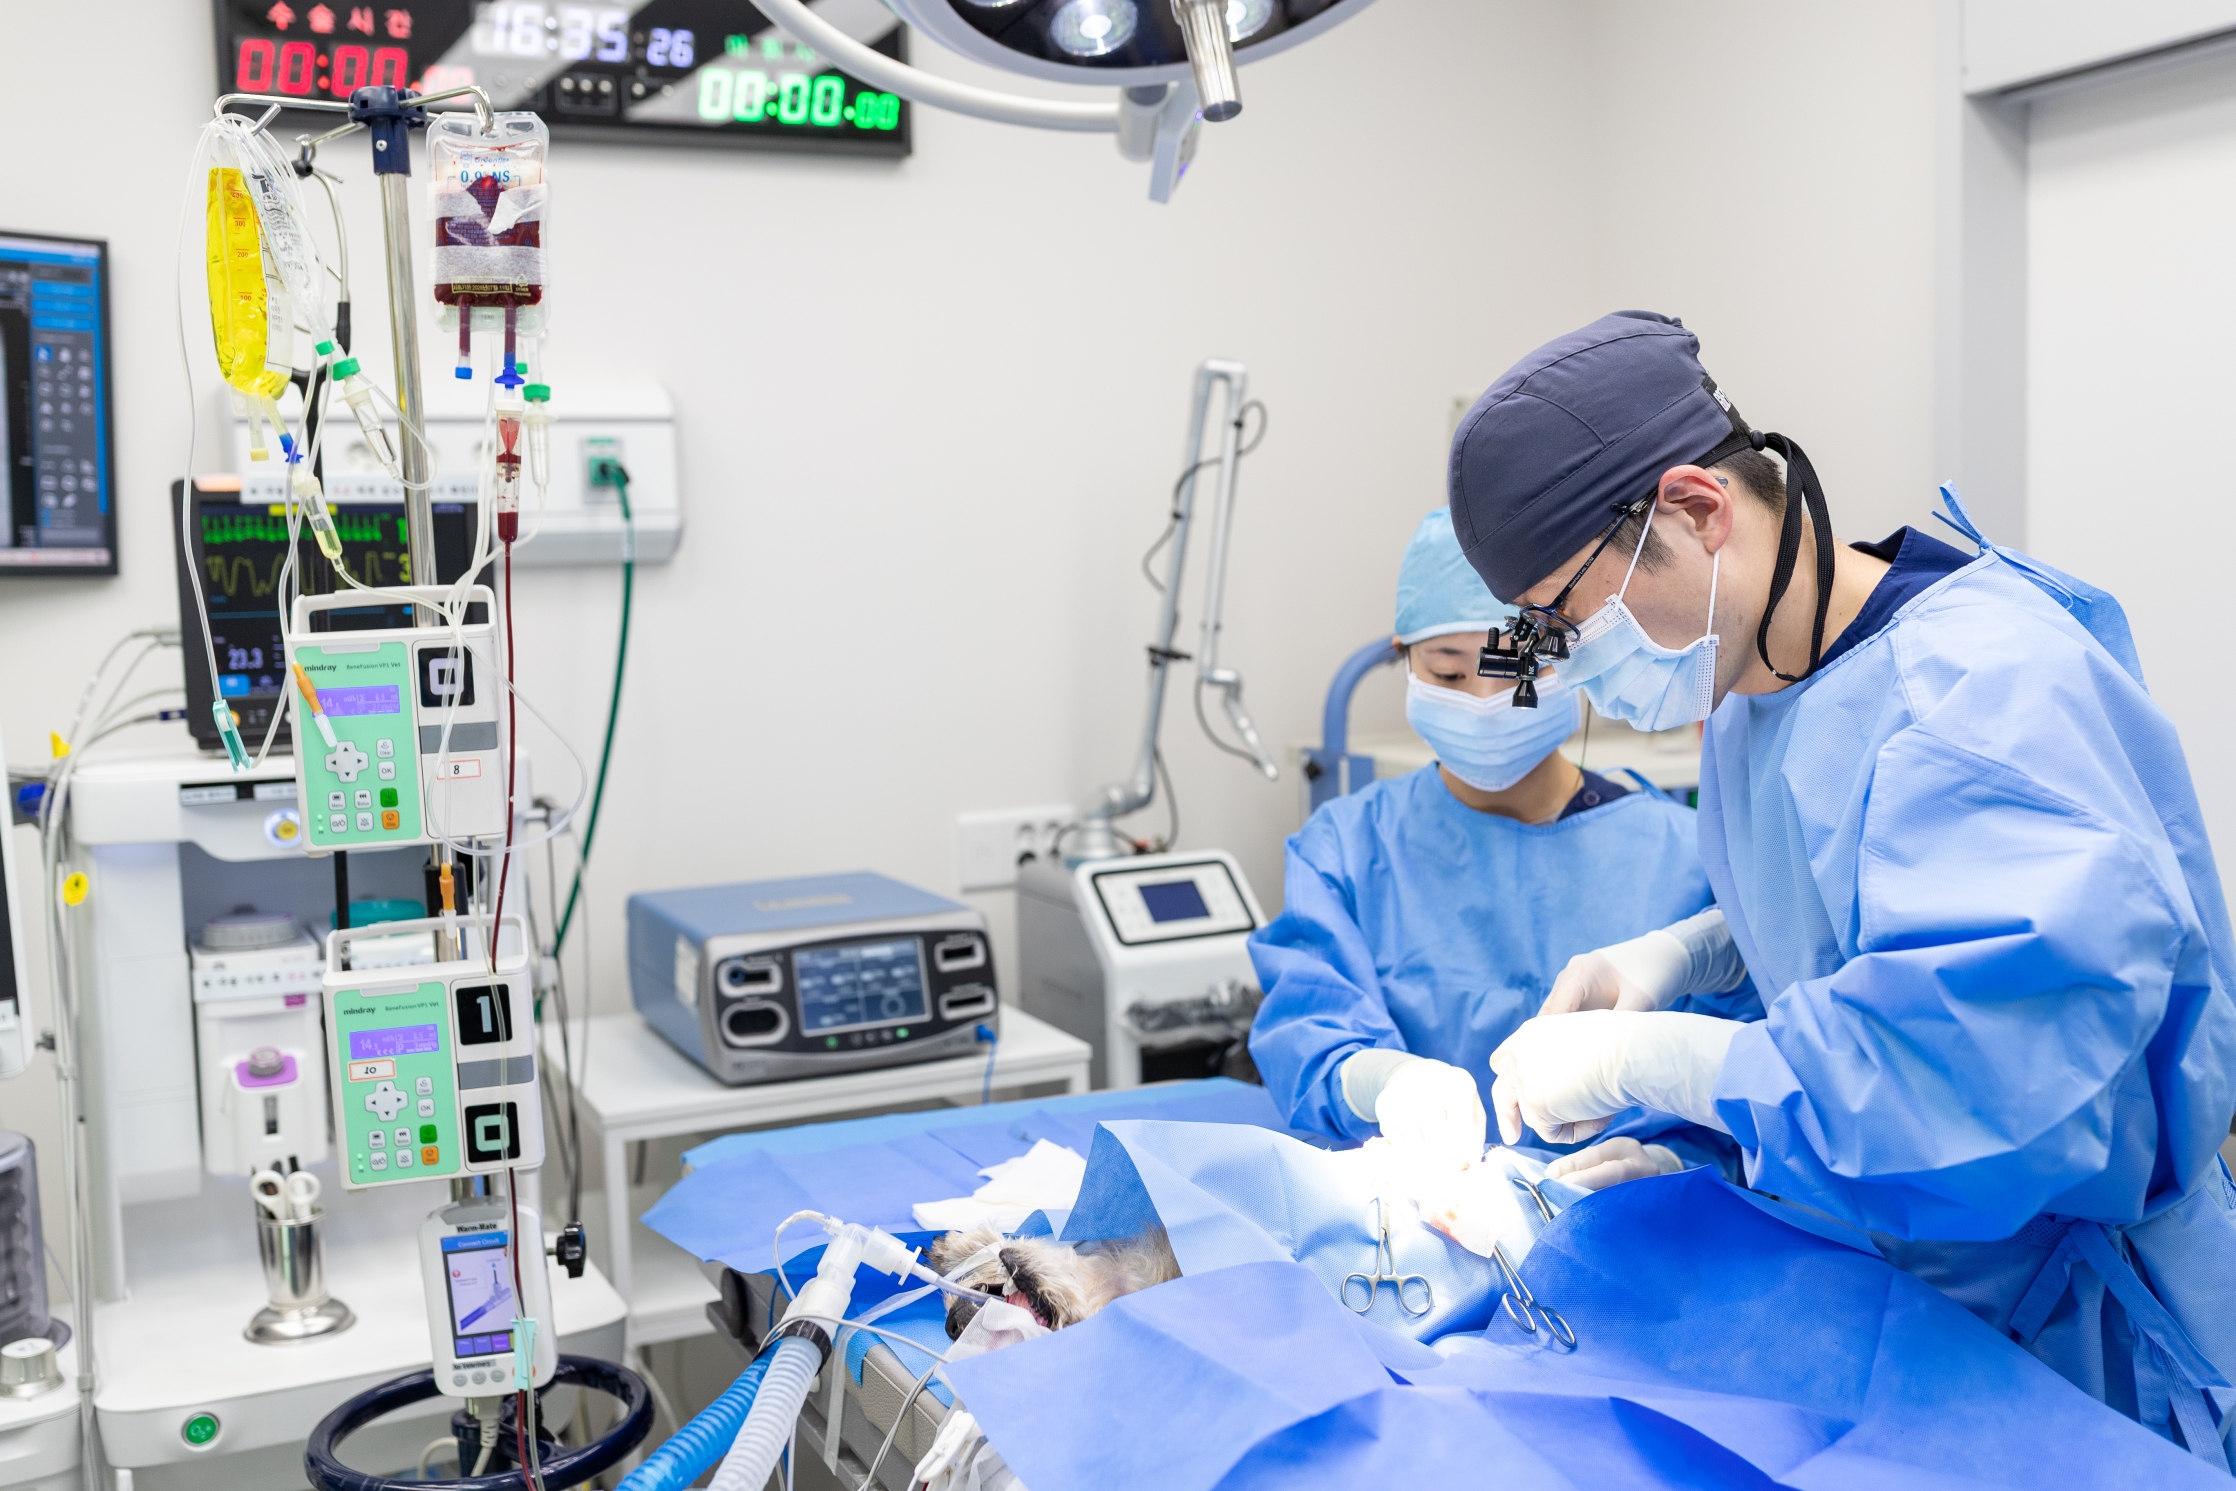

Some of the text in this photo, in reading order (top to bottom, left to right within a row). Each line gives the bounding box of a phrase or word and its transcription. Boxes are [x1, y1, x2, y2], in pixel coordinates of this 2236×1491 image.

[304, 664, 337, 672] mindray
[381, 767, 393, 775] OK
[453, 764, 460, 775] 8
[343, 1007, 376, 1016] mindray
[364, 1066, 377, 1075] 10
[456, 1223, 498, 1234] Warm-Mate
